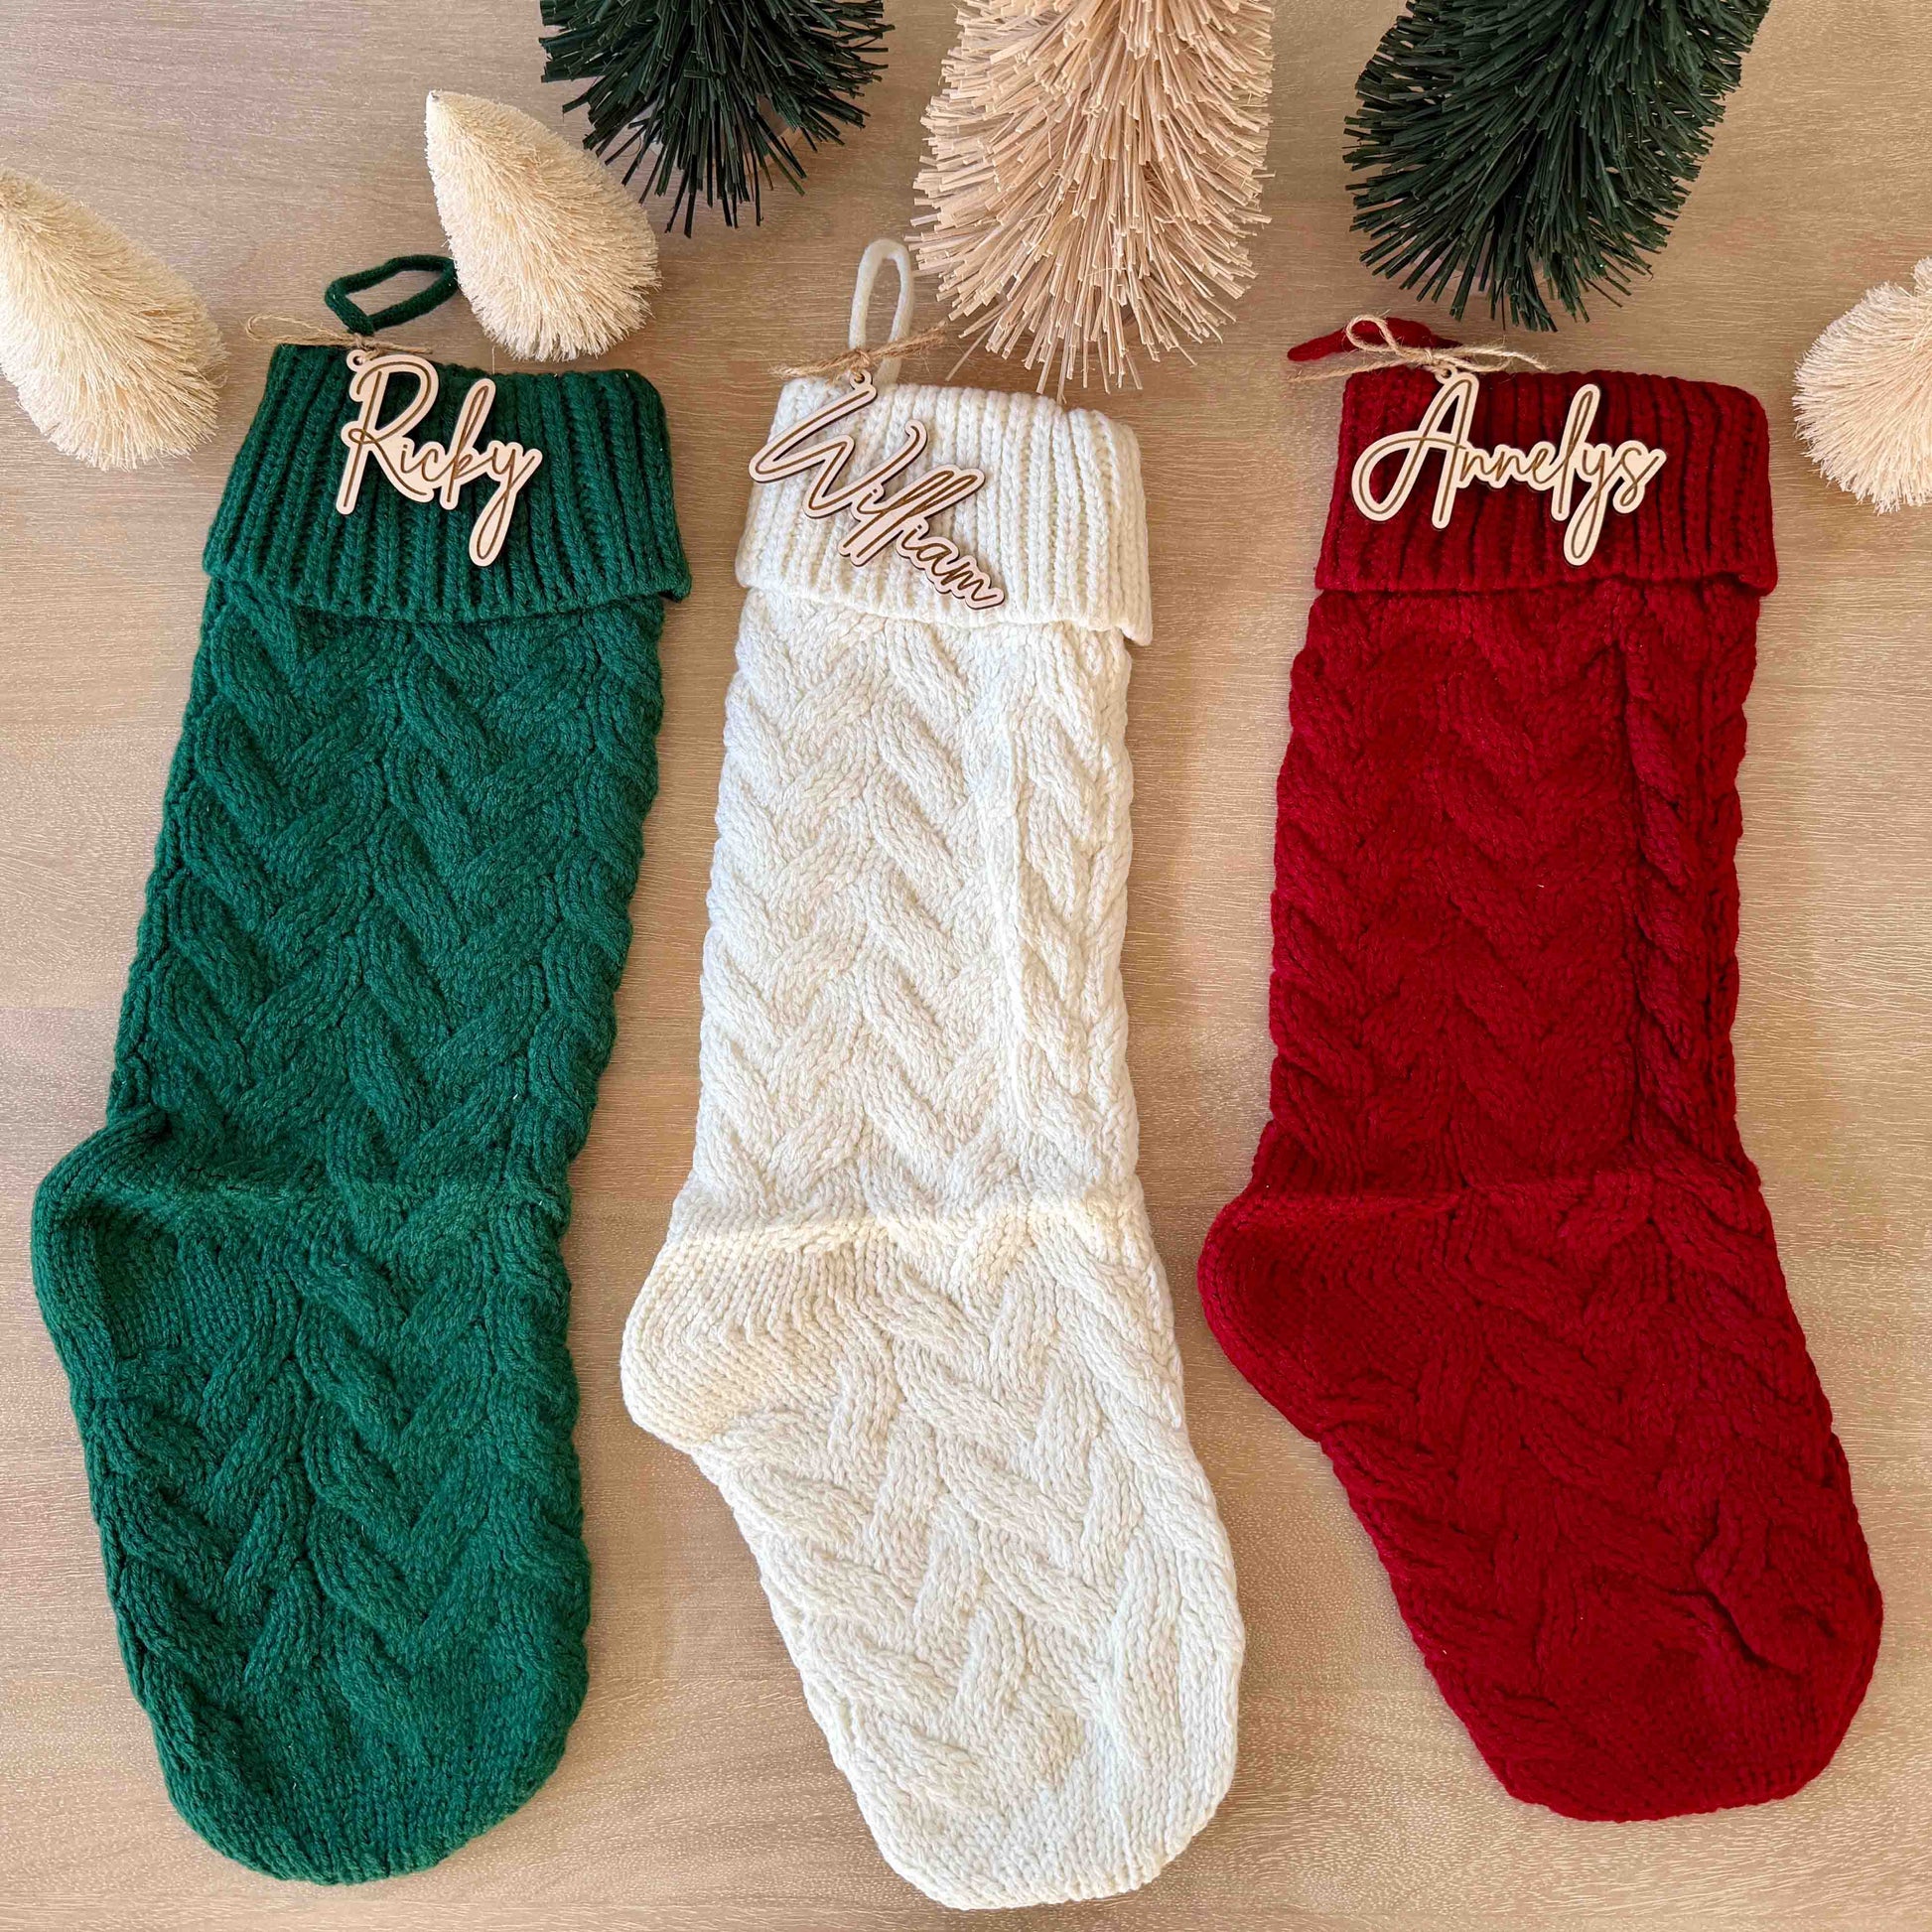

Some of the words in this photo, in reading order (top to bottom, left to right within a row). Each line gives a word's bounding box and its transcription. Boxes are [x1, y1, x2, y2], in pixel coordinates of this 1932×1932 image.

[340, 357, 539, 563] Ricky
[752, 387, 1002, 605] William
[1354, 375, 1664, 562] Annelys
